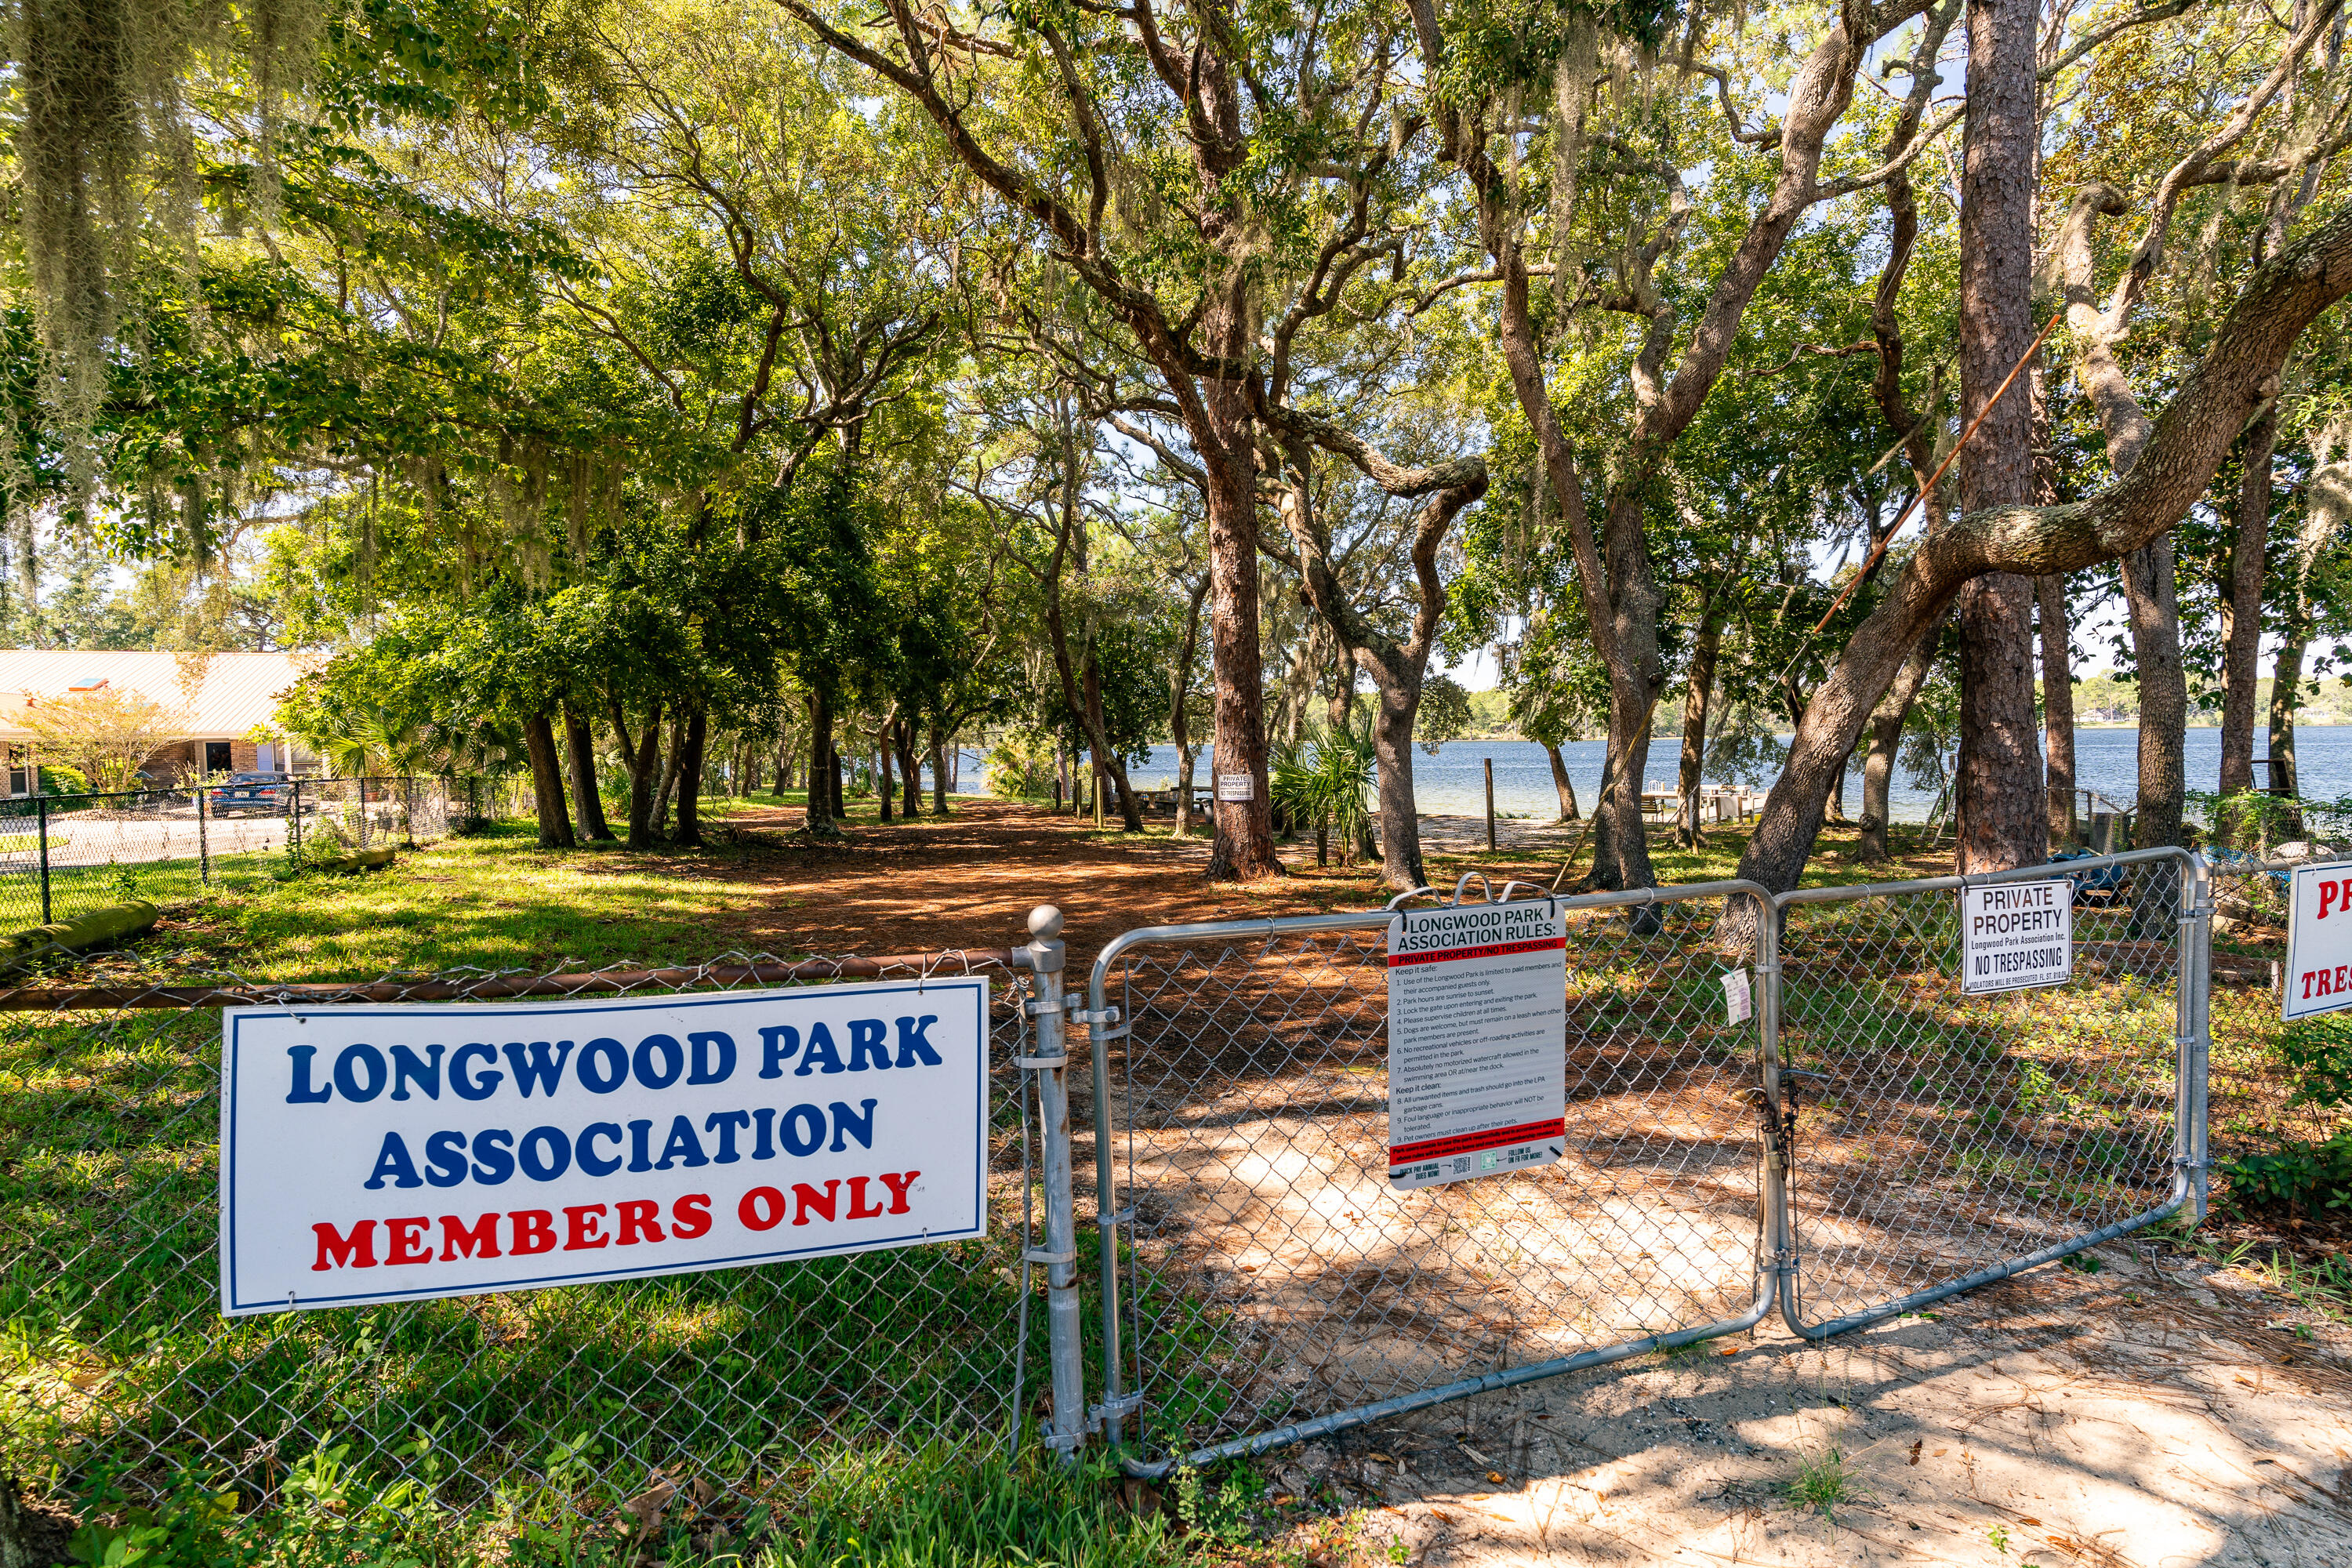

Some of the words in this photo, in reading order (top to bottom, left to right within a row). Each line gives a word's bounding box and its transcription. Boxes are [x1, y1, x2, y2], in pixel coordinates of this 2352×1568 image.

[1984, 887, 2053, 910] PRIVATE
[1410, 912, 1501, 934] LONGWOOD
[1505, 908, 1543, 924] PARK
[1974, 909, 2062, 935] PROPERTY
[1398, 927, 1501, 951] ASSOCIATION
[1506, 922, 1555, 940] RULES:
[1971, 938, 2003, 950] Longwood
[2005, 936, 2019, 946] Park
[2020, 933, 2053, 944] Association
[2056, 931, 2065, 940] Inc.
[1399, 953, 1436, 964] PRIVATE
[1437, 946, 1499, 960] PROPERTY/NO
[1501, 939, 1557, 953] TRESPASSING
[1976, 955, 1990, 975] NO
[1994, 947, 2062, 973] TRESPASSING
[1396, 967, 1414, 977] Keep
[1434, 972, 1465, 982] Longwood
[1525, 963, 1550, 971] members
[1418, 983, 1457, 994] accompanied
[1457, 981, 1477, 989] guests
[1969, 979, 1994, 989] VIOLATORS
[2013, 975, 2037, 983] PROSECUTED
[1446, 991, 1467, 1000] sunrise
[1459, 999, 1483, 1008] entering
[1495, 995, 1513, 1004] exiting
[1403, 1015, 1423, 1024] Please
[1424, 1012, 1452, 1022] supervise
[1453, 1009, 1475, 1018] children
[1403, 1026, 1419, 1035] Dogs
[1417, 1033, 1446, 1042] members
[1414, 1041, 1447, 1052] recreational
[1449, 1038, 1472, 1048] vehicles
[1479, 1033, 1510, 1044] off-roading
[1511, 1029, 1535, 1038] activities
[286, 1032, 736, 1103] LONGWOOD
[758, 1015, 942, 1079] PARK
[1403, 1053, 1432, 1064] permitted
[1403, 1062, 1434, 1074] Absolutely
[1443, 1057, 1472, 1067] motorized
[1473, 1053, 1501, 1062] watercraft
[1502, 1050, 1523, 1058] allowed
[1403, 1072, 1433, 1083] swimming
[1458, 1066, 1478, 1075] at/near
[1396, 1085, 1414, 1095] Keep
[1412, 1092, 1441, 1102] unwanted
[1486, 1082, 1504, 1091] should
[1403, 1104, 1428, 1114] garbage
[1417, 1111, 1443, 1122] language
[1452, 1103, 1489, 1116] inappropriate
[1490, 1100, 1512, 1109] behavior
[1415, 1132, 1436, 1141] owners
[1452, 1126, 1468, 1134] clean
[364, 1099, 877, 1189] ASSOCIATION
[313, 1195, 712, 1271] MEMBERS
[739, 1171, 920, 1231] ONLY
